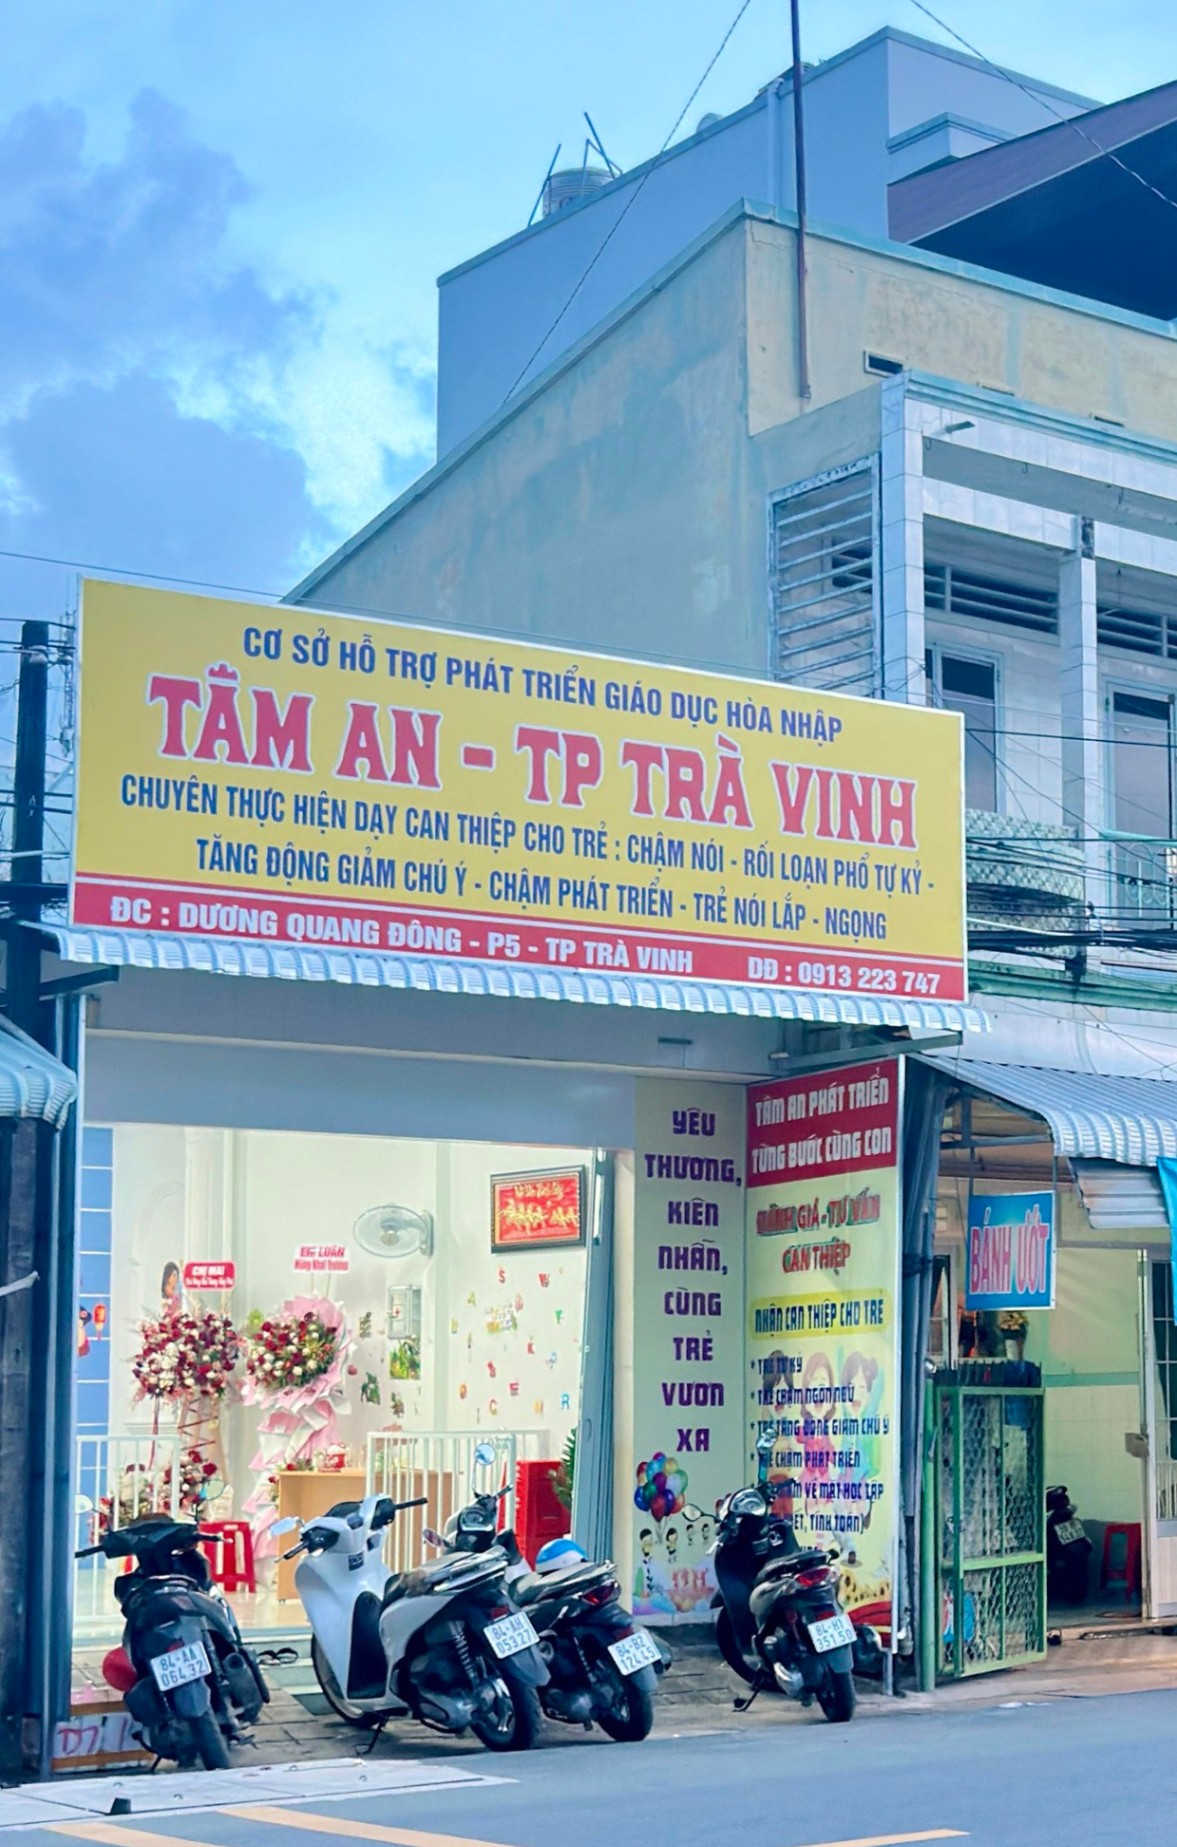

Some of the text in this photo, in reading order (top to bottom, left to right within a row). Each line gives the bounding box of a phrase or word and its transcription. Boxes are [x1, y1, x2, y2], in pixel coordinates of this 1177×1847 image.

[243, 627, 843, 747] CƠ SỞ HỖ TRỢ PHÁT TRIỂN GIÁO DỤC HÒA NHẬP
[148, 662, 314, 773] TÂM
[336, 702, 442, 789] AN
[516, 726, 602, 807] TP
[621, 733, 754, 829] TRÀ
[770, 761, 917, 849] VINH
[121, 774, 218, 815] CHUYÊN
[226, 785, 286, 828] THỰC
[293, 790, 347, 835] HIỆN
[355, 800, 398, 840] DẠY
[405, 807, 450, 842] CAN
[457, 811, 517, 854] THIỆP
[524, 822, 565, 855] CHO
[571, 820, 608, 860] TRẺ
[627, 832, 684, 873] CHẬM
[691, 838, 724, 873] NÓI
[744, 840, 775, 879] RỐI
[780, 853, 828, 890] LOẠN
[834, 851, 869, 890] PHỔ
[874, 863, 897, 899] TỰ
[901, 859, 923, 896] KỶ
[196, 833, 258, 875] TĂNG
[266, 842, 330, 887] ĐỘNG
[337, 846, 396, 889] GIẢM
[403, 858, 448, 895] CHÚ
[455, 860, 468, 897] Ý
[489, 868, 551, 910] CHẬM
[558, 875, 610, 912] PHÁT
[616, 875, 673, 918] TRIỂN
[693, 885, 728, 924] TRẺ
[734, 893, 766, 928] NÓI
[772, 892, 806, 931] LẮP
[825, 907, 887, 943] NGỌNG
[110, 896, 152, 925] ĐC
[178, 901, 279, 936] DƯƠNG
[286, 913, 380, 946] QUANG
[387, 919, 462, 953] ĐÔNG
[487, 931, 521, 958] P5
[545, 936, 577, 963] TP
[583, 939, 630, 969] TRÀ
[636, 945, 694, 973] VINH
[748, 955, 779, 982] DĐ
[798, 960, 853, 988] 0913
[857, 966, 898, 991] 223
[902, 970, 941, 995] 747
[755, 1067, 890, 1128] TÂM AN PHÁT TRIỂN
[672, 1107, 716, 1137] YÊU
[825, 1129, 862, 1162] CÙNG
[864, 1126, 892, 1156] CON
[644, 1153, 743, 1187] THƯƠNG,
[667, 1197, 719, 1227] KIÊN
[782, 1245, 811, 1274] CAN
[969, 1204, 1050, 1295] BÁNH ƯỚT
[664, 1287, 722, 1317] CÙNG
[755, 1289, 884, 1337] NHẬN CAN THIỆP CHO TRẺ
[673, 1329, 714, 1361] TRẺ
[661, 1382, 725, 1407] VƯƠN
[676, 1428, 710, 1453] XA
